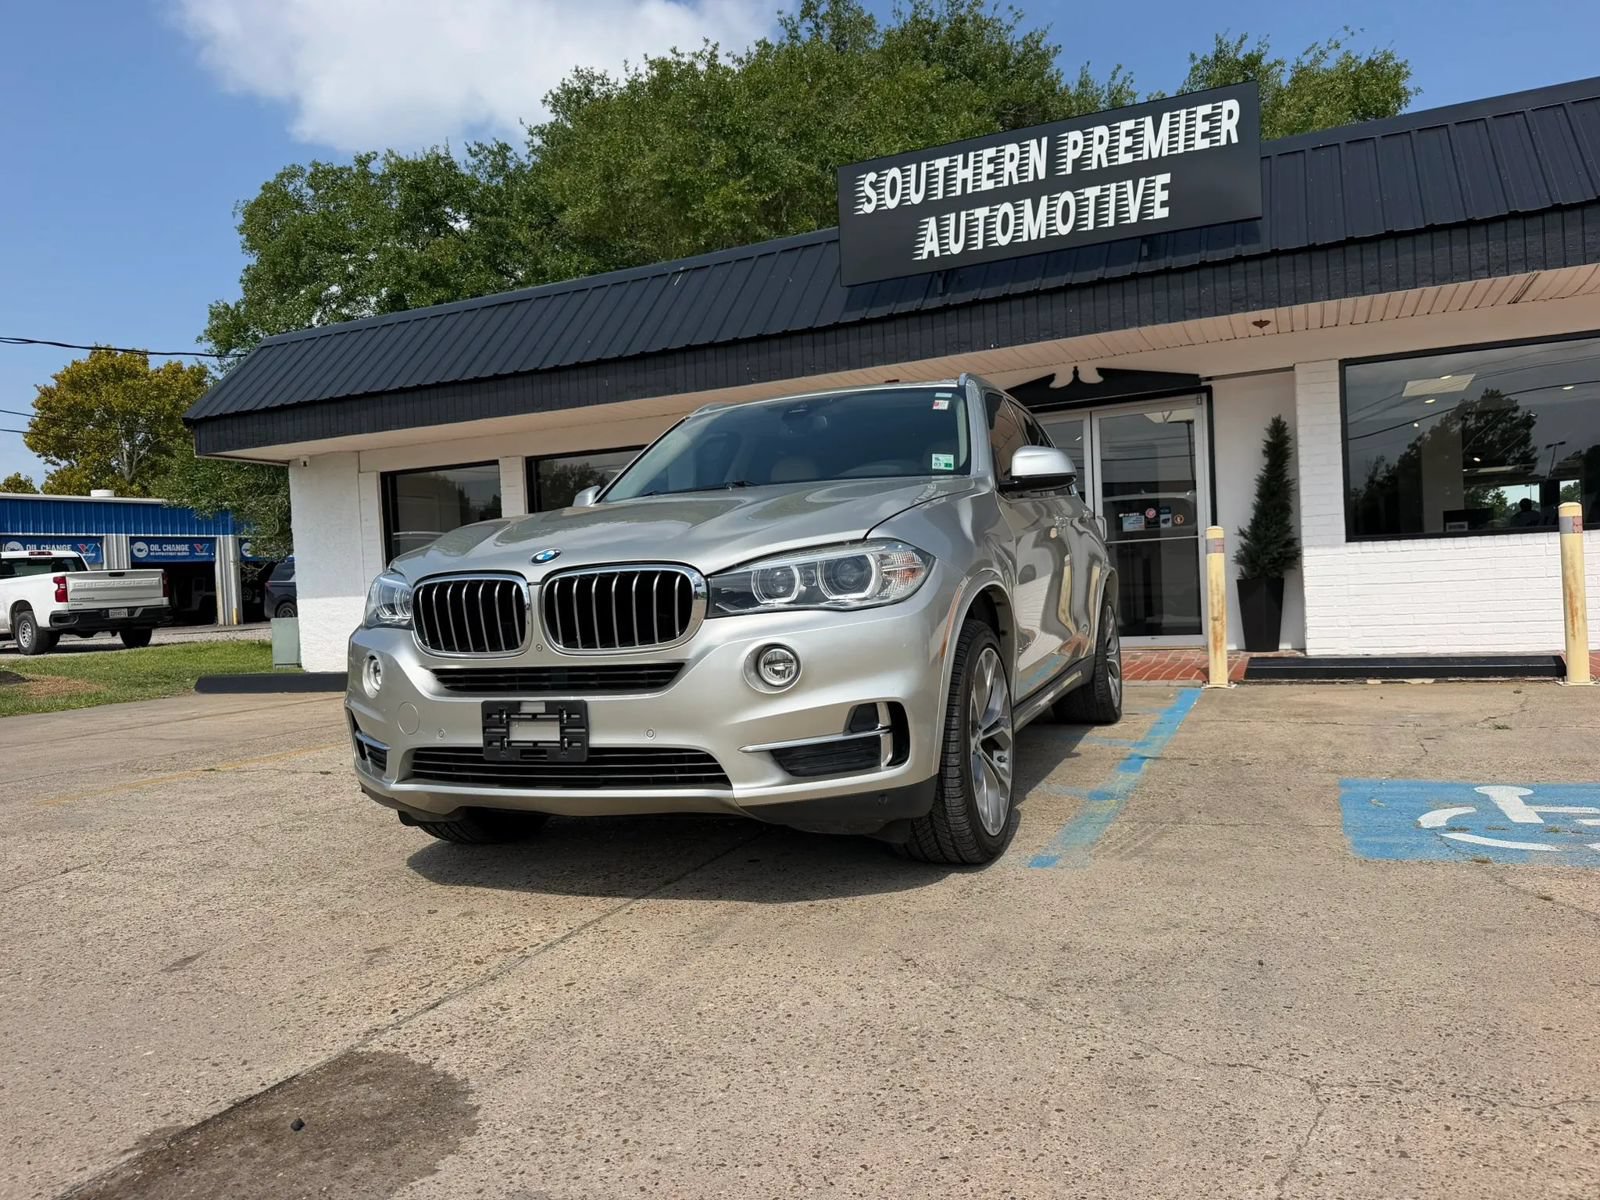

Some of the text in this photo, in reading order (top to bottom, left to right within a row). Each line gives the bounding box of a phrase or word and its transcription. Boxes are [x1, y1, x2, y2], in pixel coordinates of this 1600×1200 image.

[853, 98, 1240, 216] SOUTHERN PREMIER
[912, 172, 1171, 261] AUTOMOTIVE
